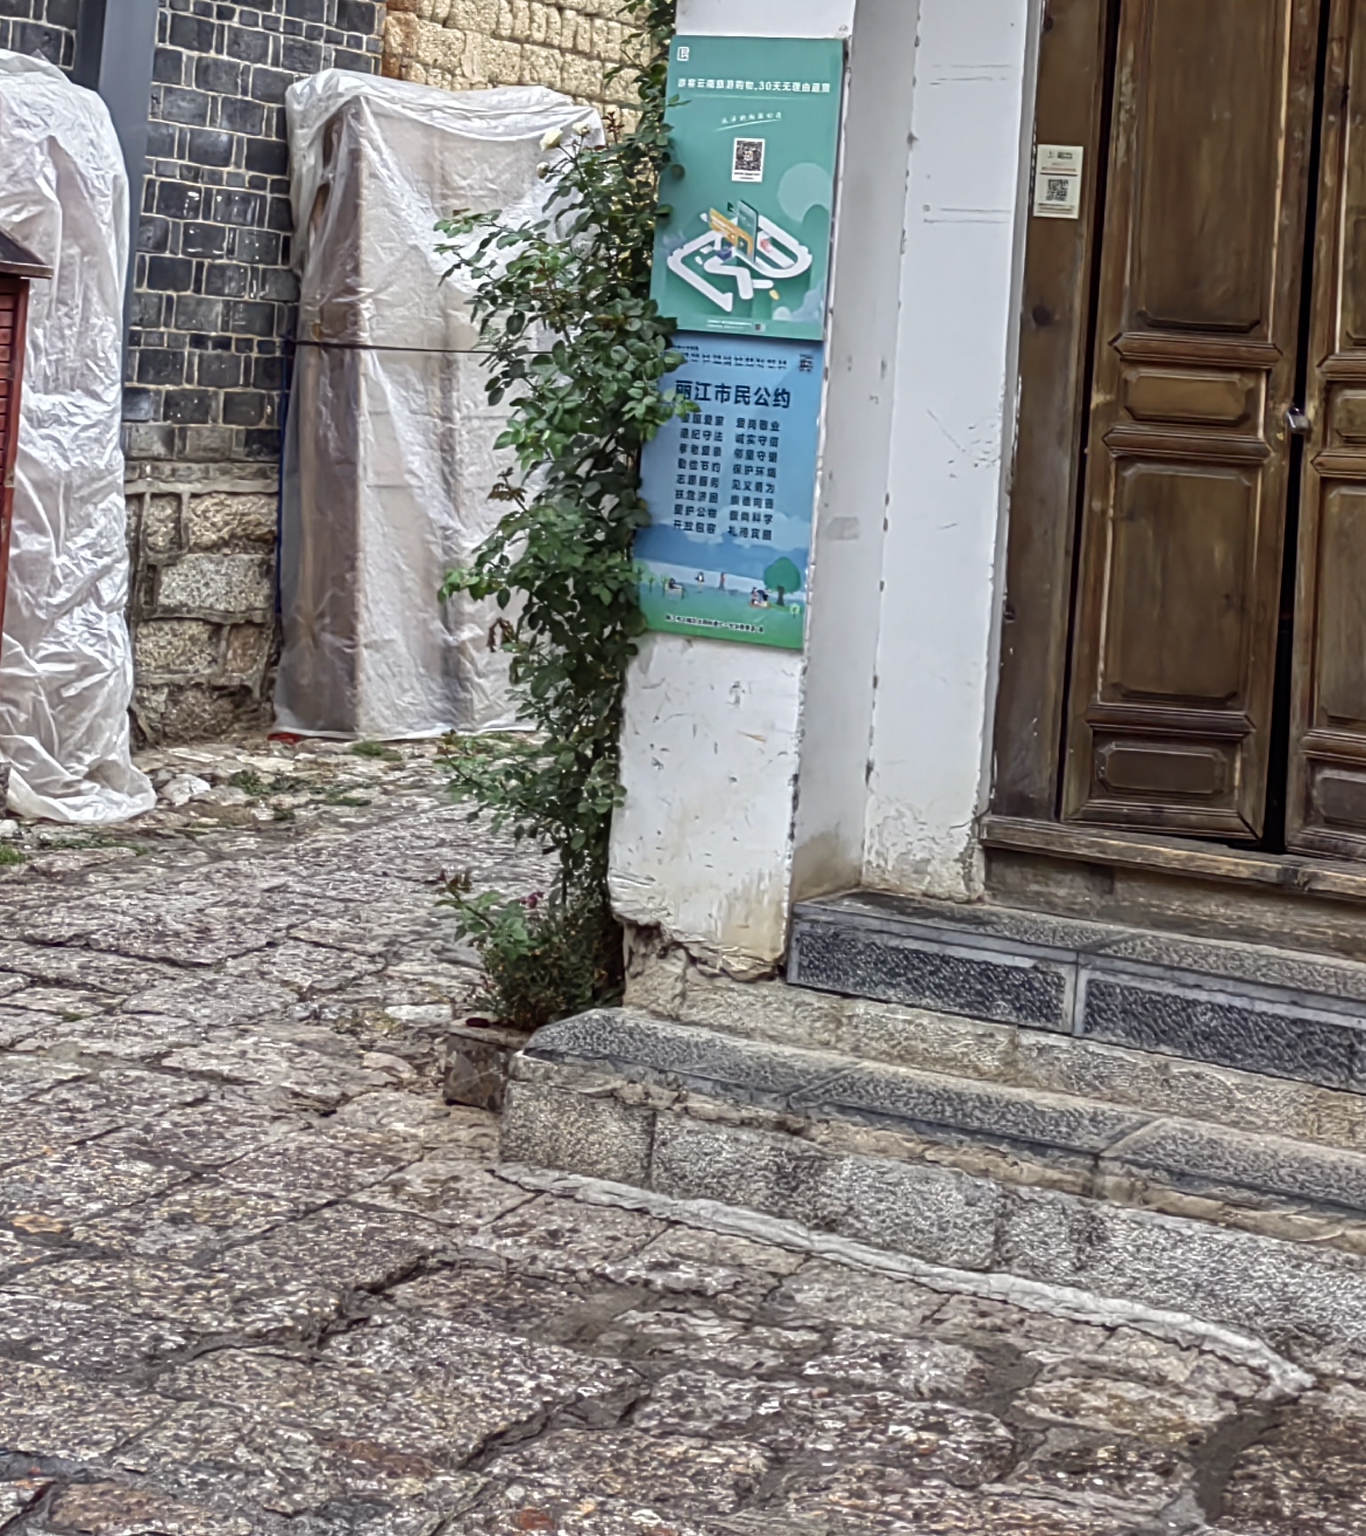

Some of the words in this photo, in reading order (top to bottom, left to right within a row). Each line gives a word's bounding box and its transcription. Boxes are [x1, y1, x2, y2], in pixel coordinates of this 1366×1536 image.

[675, 379, 791, 409] 丽江市民公约
